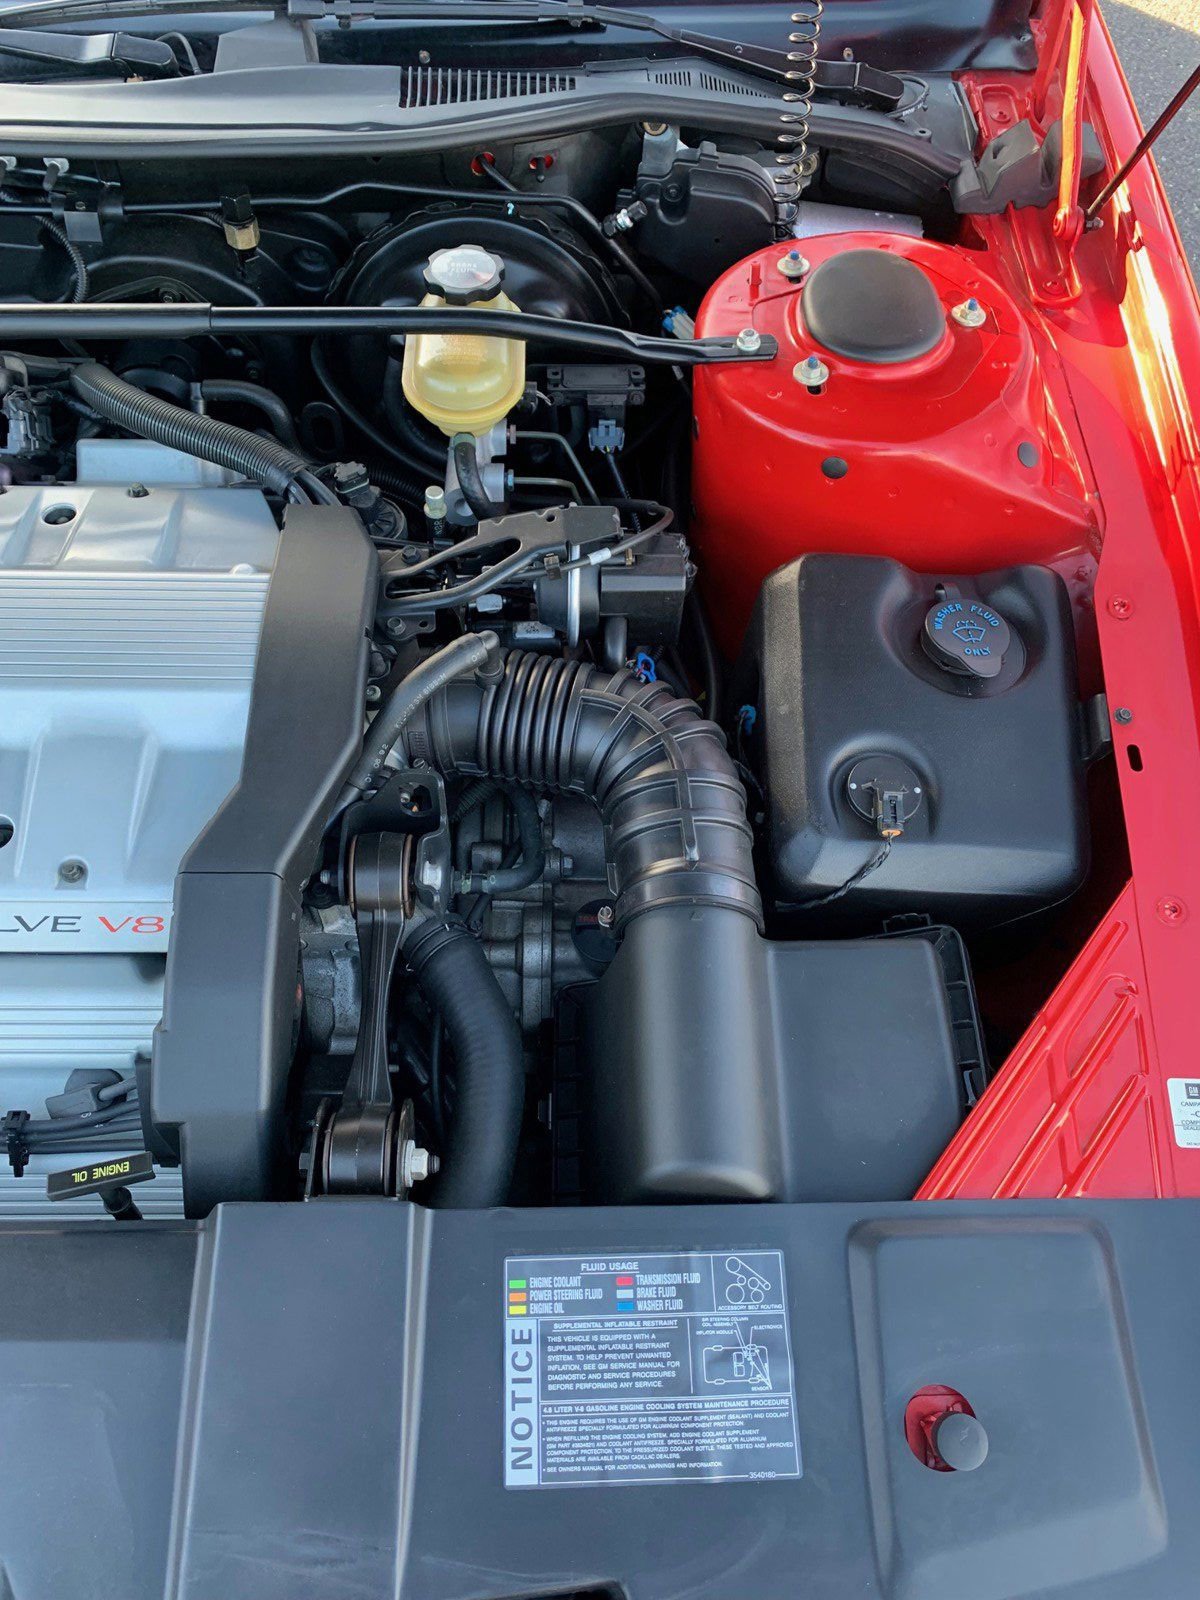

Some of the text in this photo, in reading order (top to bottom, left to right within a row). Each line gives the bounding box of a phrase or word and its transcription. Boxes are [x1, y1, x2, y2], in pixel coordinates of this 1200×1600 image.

[935, 604, 999, 630] WASHER FLUID
[964, 647, 991, 656] ONLY
[98, 916, 164, 933] V8
[72, 1162, 129, 1182] ENGINE OIL
[581, 1262, 639, 1271] FLUID USAGE
[530, 1276, 581, 1288] ENGINE COOLANT
[636, 1273, 700, 1285] TRANSMISSION FLUID
[530, 1288, 602, 1301] POWER STEERING FLUID
[636, 1286, 676, 1298] BRAKE FLUID
[530, 1302, 564, 1314] ENGINE OIL
[637, 1299, 683, 1311] WASHER FLUID
[511, 1329, 532, 1470] NOTICE
